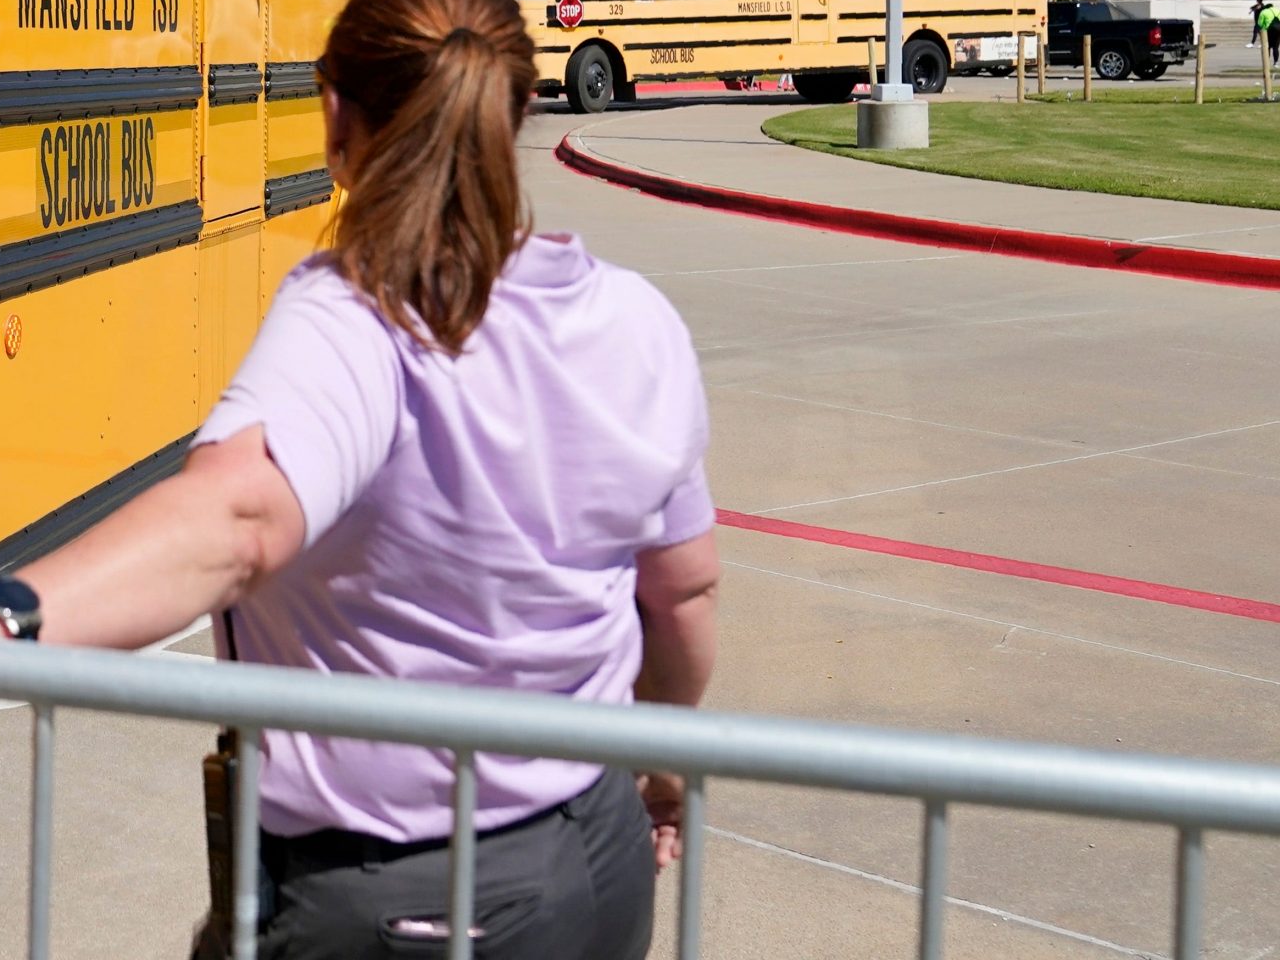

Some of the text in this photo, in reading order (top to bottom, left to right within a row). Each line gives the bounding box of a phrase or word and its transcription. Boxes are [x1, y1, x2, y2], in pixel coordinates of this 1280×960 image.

[561, 5, 581, 18] STOP
[609, 4, 624, 16] 329
[737, 2, 771, 14] MANSFIELD
[650, 48, 695, 65] SCHOOL BUS
[40, 116, 154, 229] SCHOOL BUS
